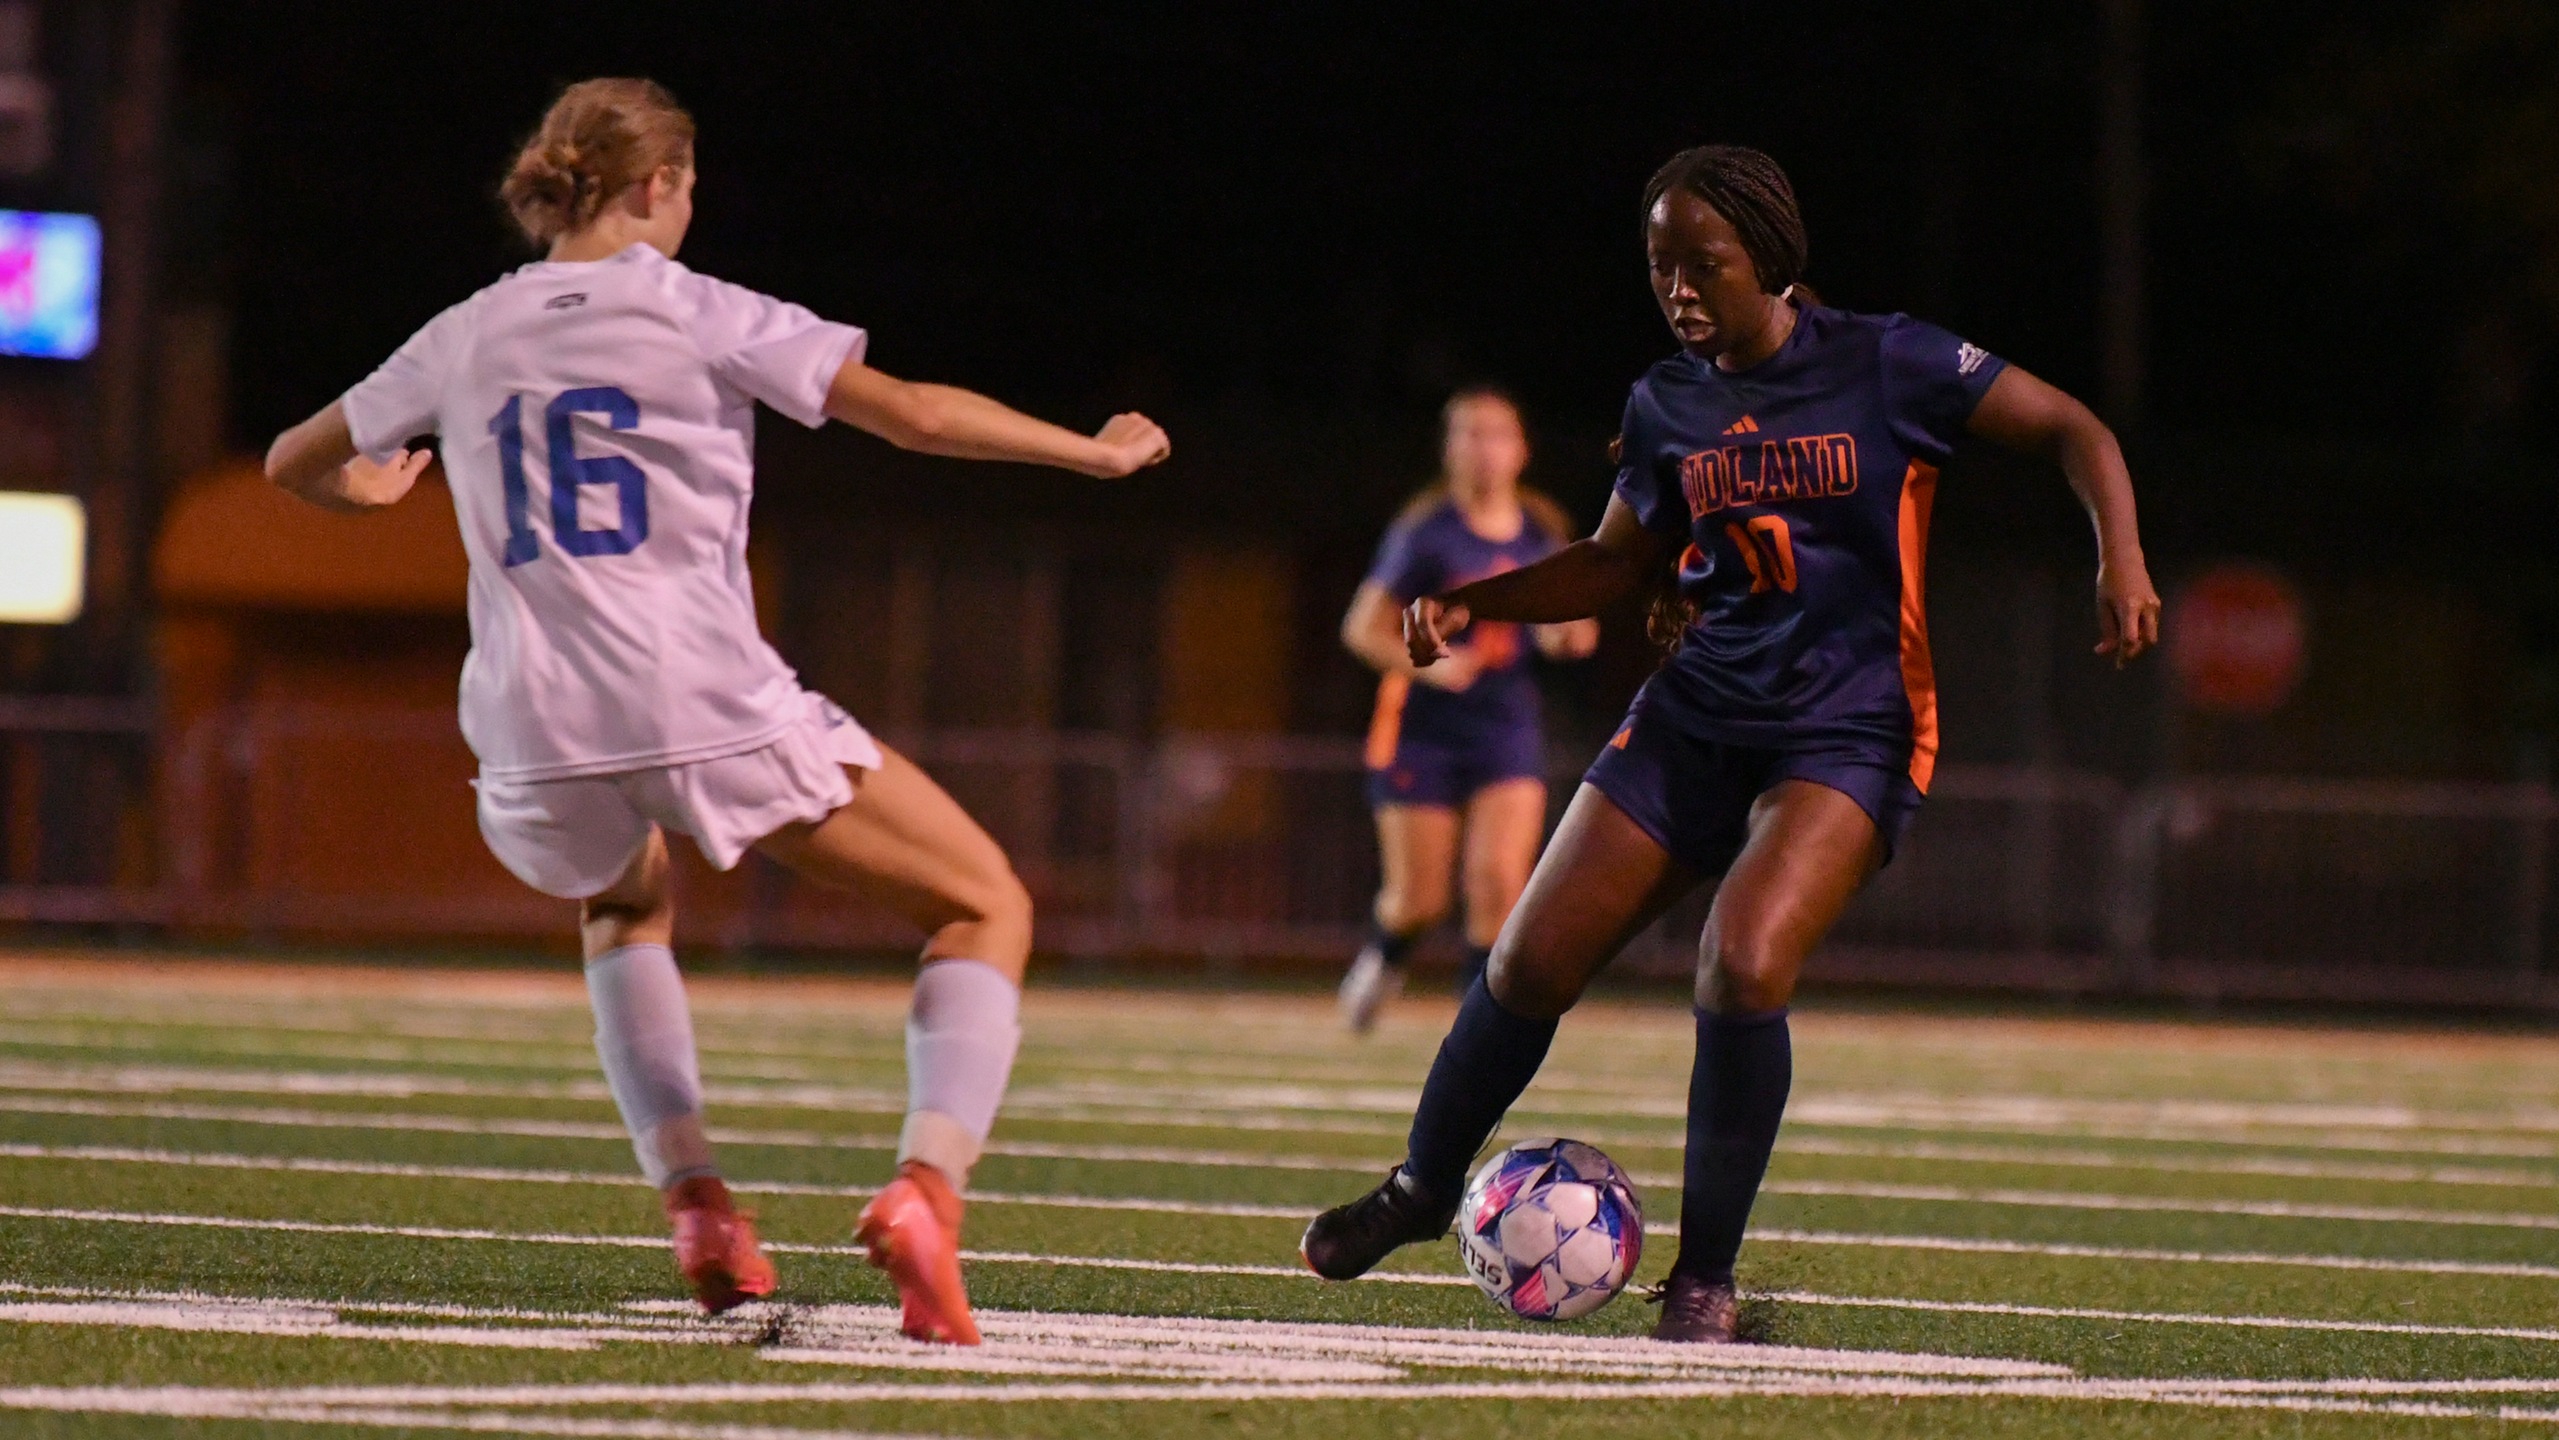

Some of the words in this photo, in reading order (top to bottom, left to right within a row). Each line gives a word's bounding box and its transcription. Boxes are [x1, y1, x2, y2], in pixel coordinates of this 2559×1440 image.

[487, 386, 648, 568] 16
[1681, 432, 1859, 520] IDLAND
[1724, 514, 1798, 594] 10
[1459, 1231, 1503, 1286] SELE
